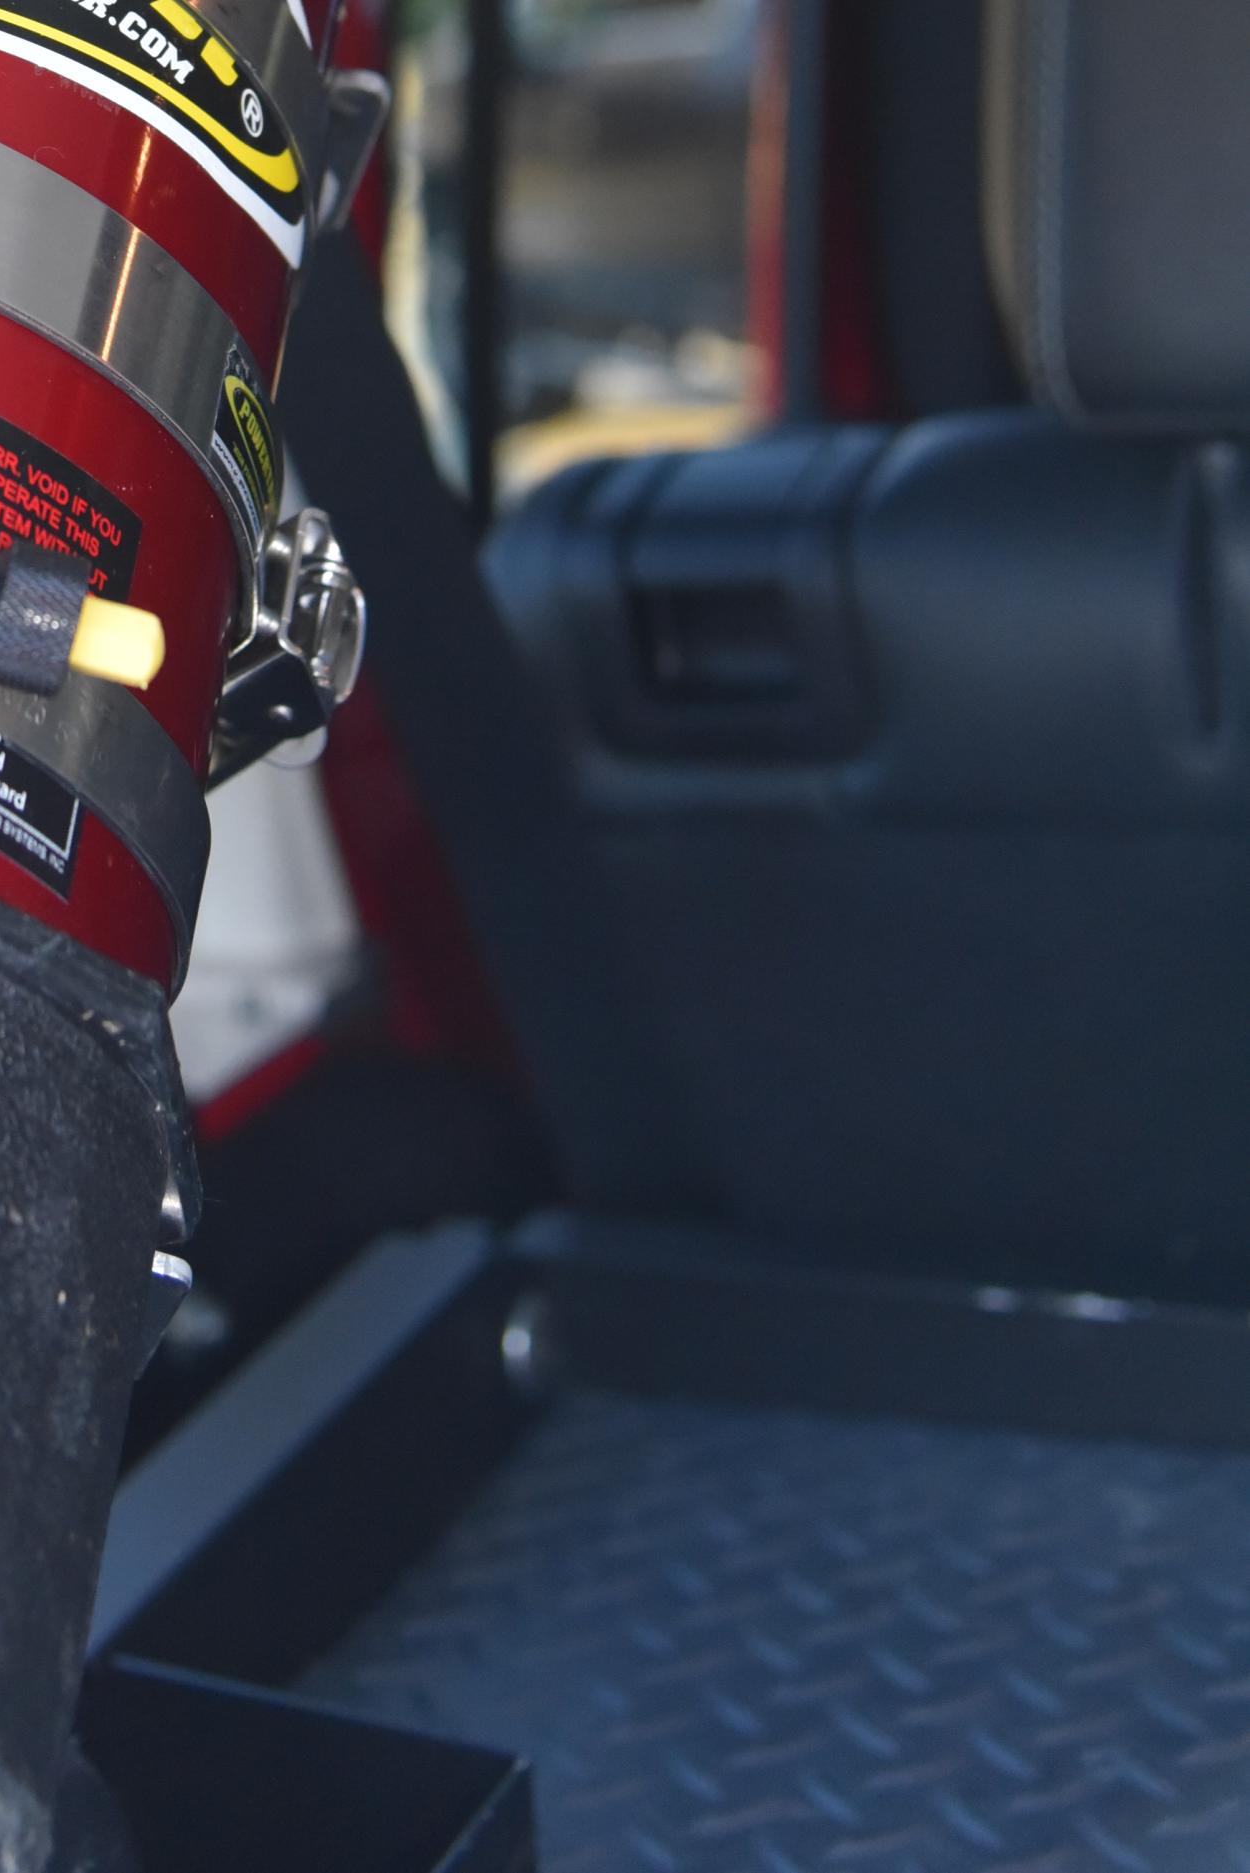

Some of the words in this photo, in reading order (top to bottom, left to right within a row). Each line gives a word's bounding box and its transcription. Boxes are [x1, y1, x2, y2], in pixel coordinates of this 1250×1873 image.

[27, 464, 70, 505] VOID
[72, 495, 88, 517] IF
[90, 508, 122, 547] YOU
[65, 516, 100, 557] THIS
